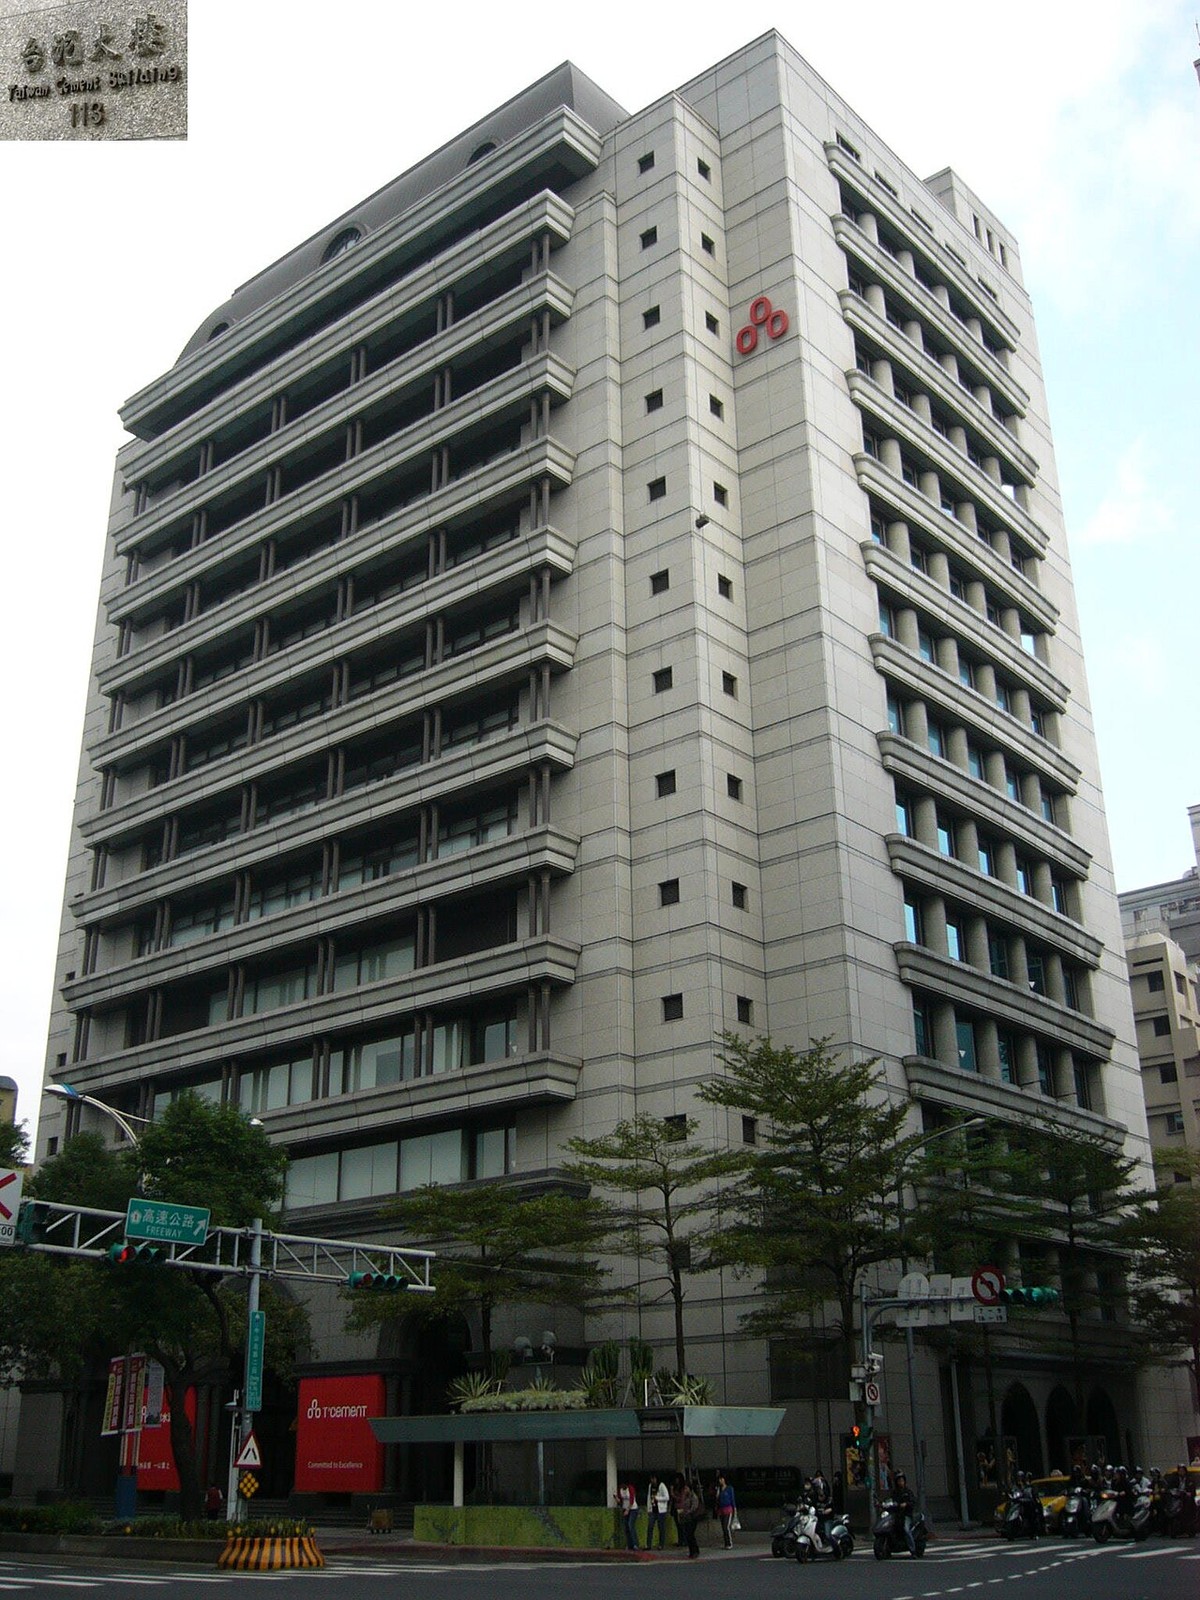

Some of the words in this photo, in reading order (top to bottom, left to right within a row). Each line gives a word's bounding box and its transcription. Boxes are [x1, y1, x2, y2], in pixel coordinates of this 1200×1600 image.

[8, 84, 51, 102] Taiwan
[56, 76, 101, 96] Cement
[108, 66, 181, 90] Building
[69, 102, 105, 128] 113
[142, 1208, 195, 1228] 高速公路
[146, 1225, 182, 1238] FREEWAY
